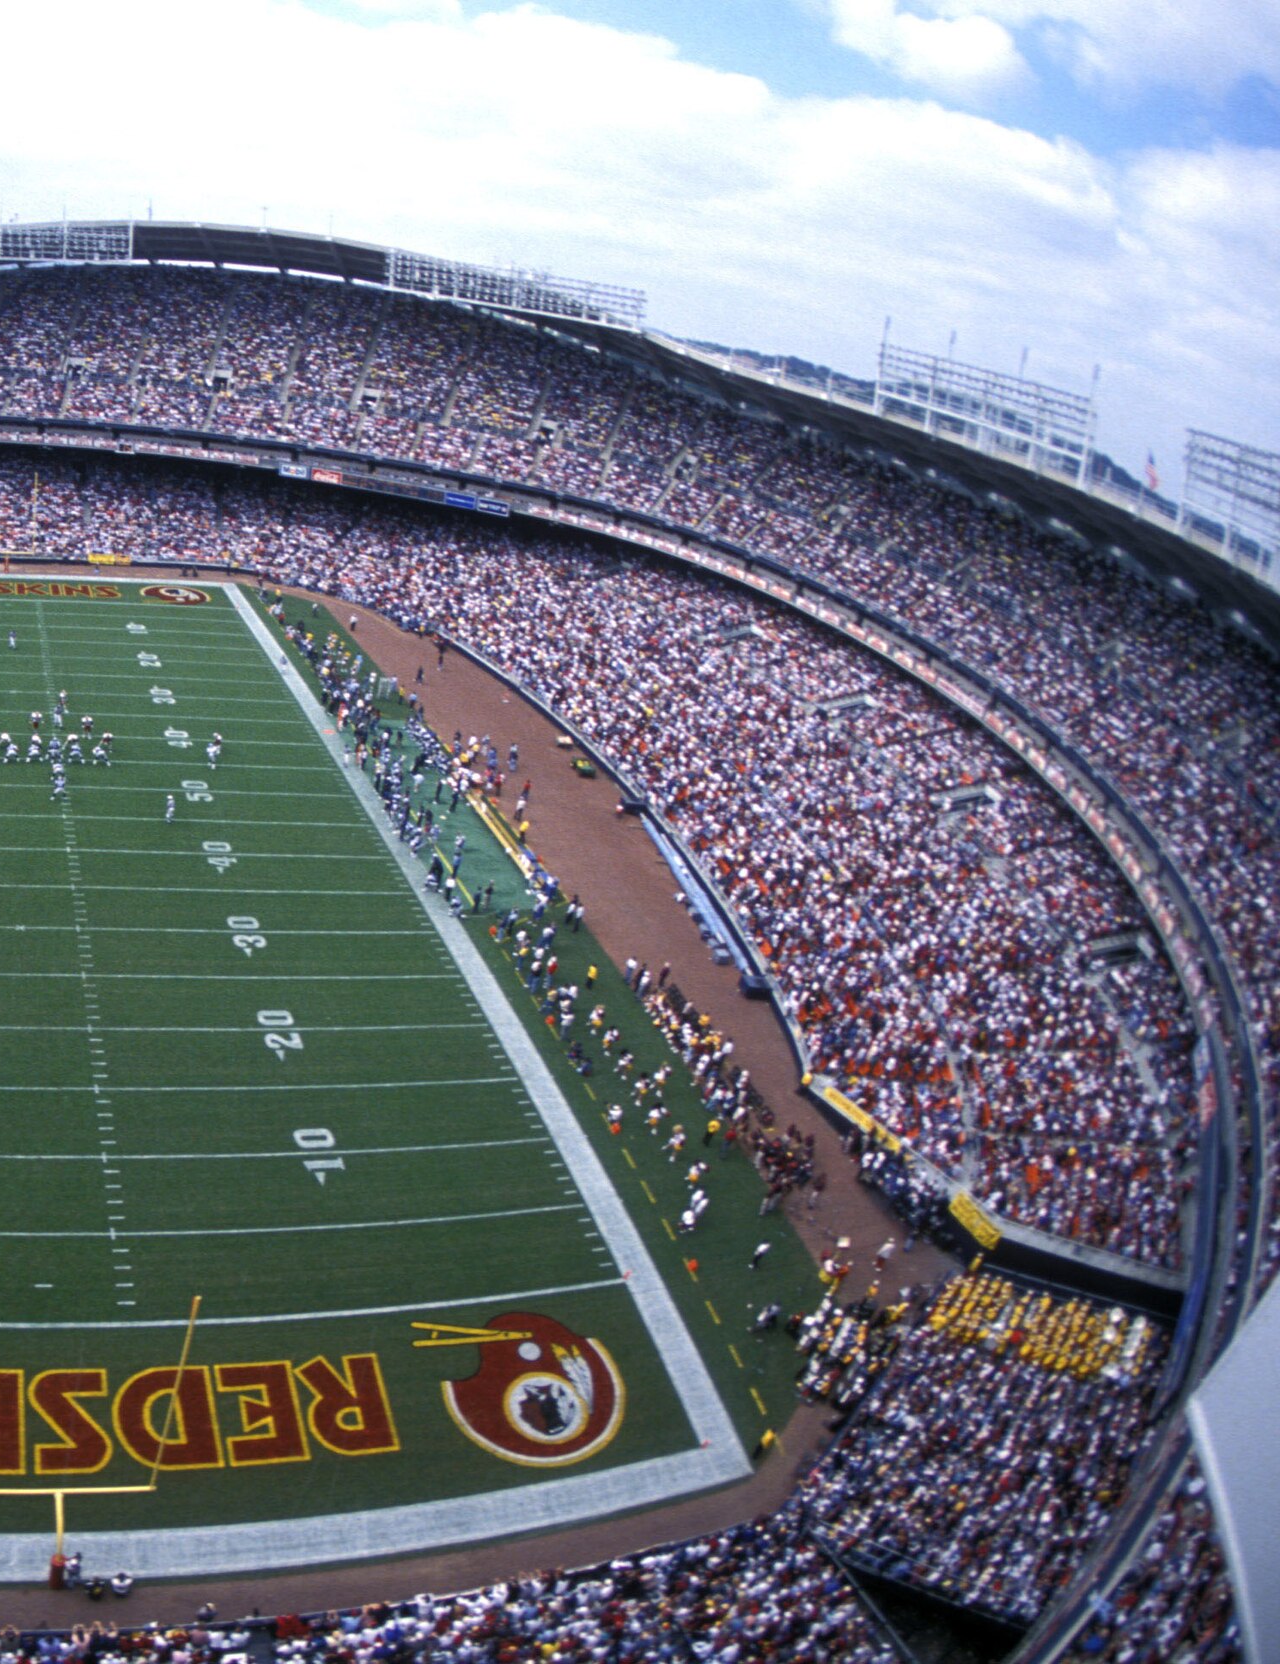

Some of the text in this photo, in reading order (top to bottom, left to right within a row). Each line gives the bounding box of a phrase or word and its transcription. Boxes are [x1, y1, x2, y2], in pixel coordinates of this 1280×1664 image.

[181, 780, 214, 802] 50
[202, 841, 237, 868] 40
[226, 915, 267, 949] 30
[257, 1010, 304, 1050] 20
[292, 1127, 346, 1172] 10
